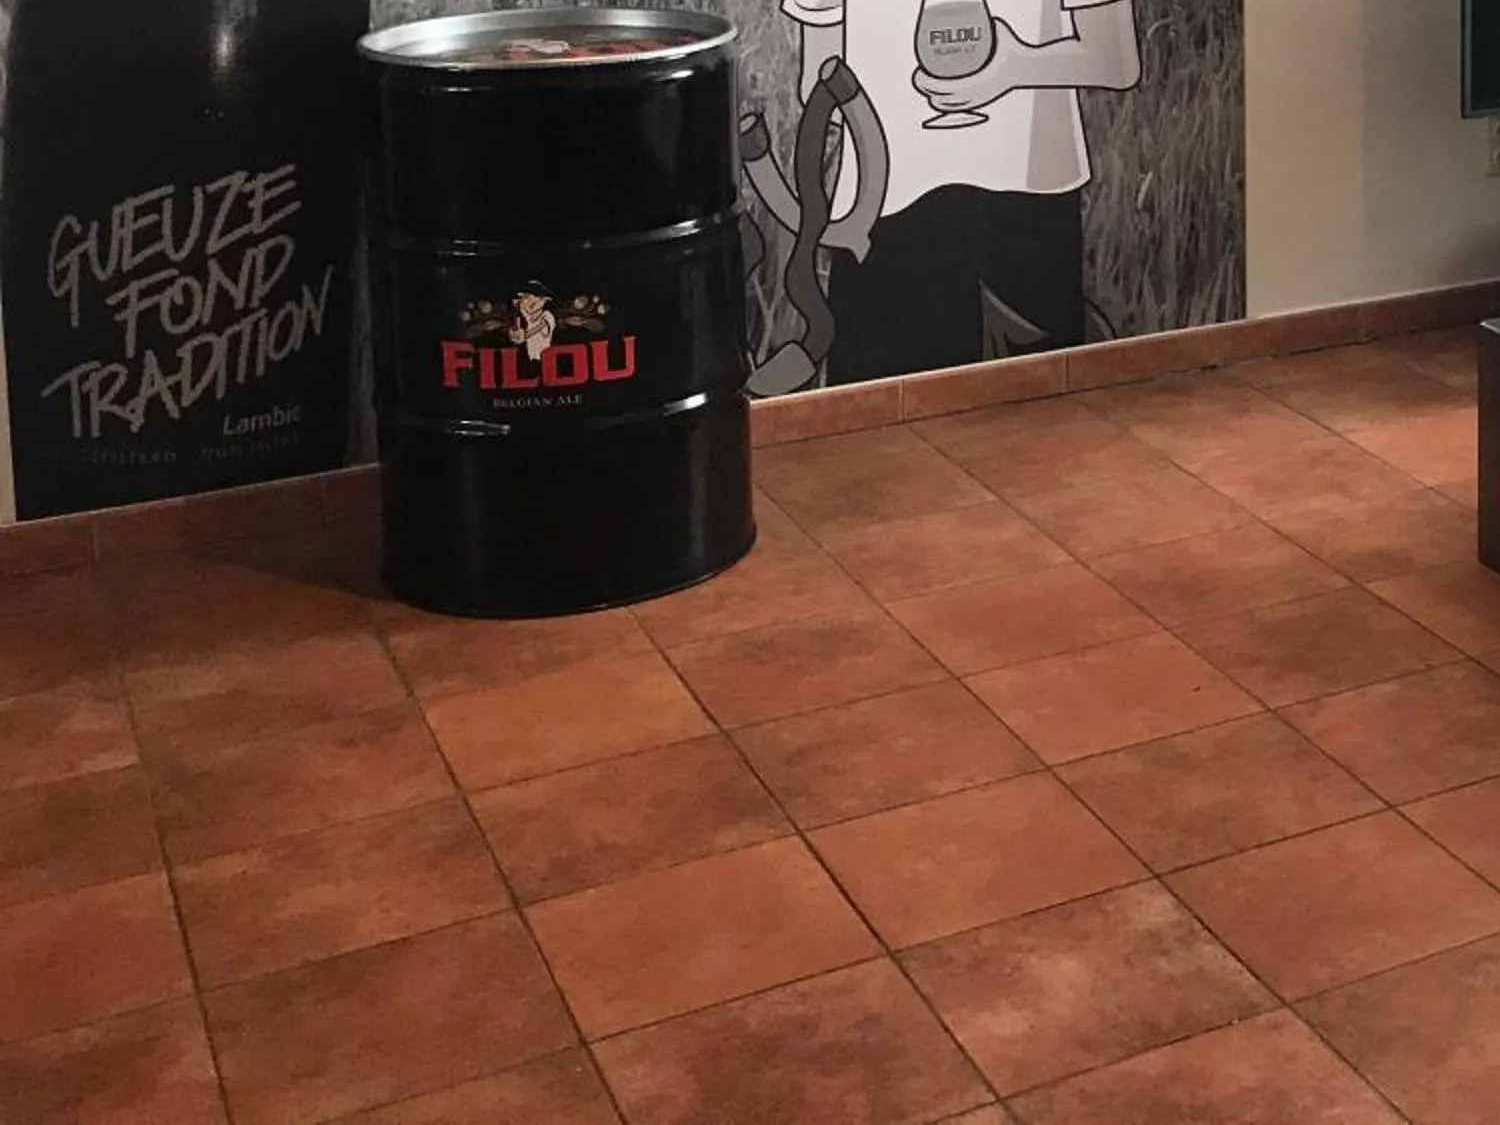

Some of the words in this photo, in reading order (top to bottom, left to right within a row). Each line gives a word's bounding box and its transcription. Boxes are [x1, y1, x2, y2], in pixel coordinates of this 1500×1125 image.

[929, 26, 982, 46] FILOU
[48, 163, 302, 328] GUEUZE
[105, 234, 295, 359] FOND
[40, 264, 334, 438] TRADITION
[440, 335, 638, 390] FILOU
[222, 402, 303, 436] Lambic
[492, 394, 553, 410] BELGIAN
[556, 392, 584, 407] ALE
